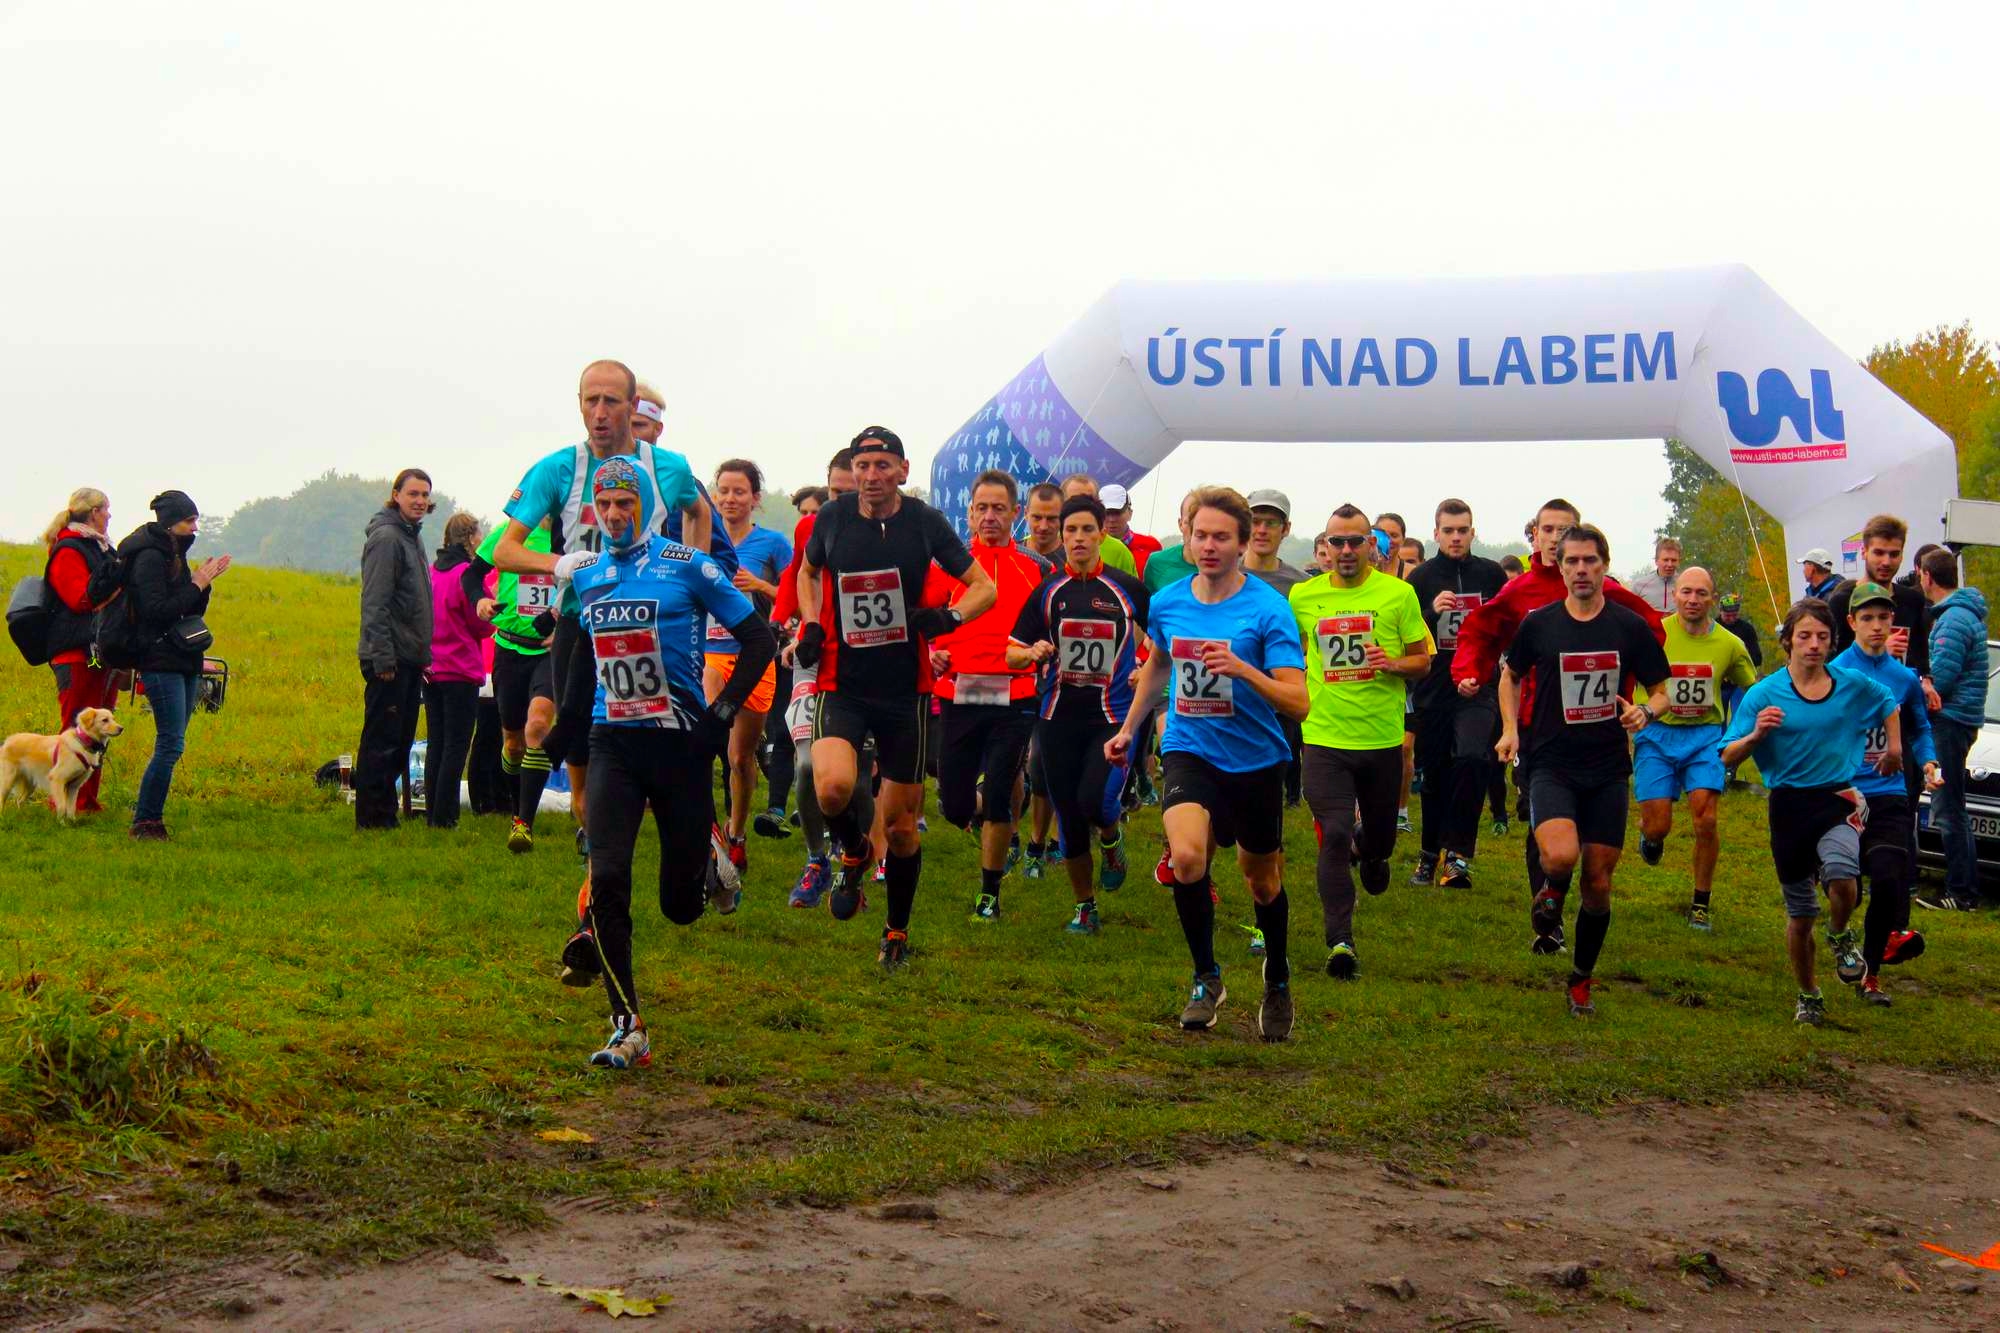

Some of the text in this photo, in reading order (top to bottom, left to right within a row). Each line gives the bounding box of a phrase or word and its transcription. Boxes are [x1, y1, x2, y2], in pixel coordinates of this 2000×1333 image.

[1148, 327, 1678, 387] ÚSTÍ NAD LABEM
[1731, 448, 1846, 462] www.usti-nad-labem.cz
[663, 550, 691, 560] BANK
[529, 586, 549, 606] 31
[853, 593, 894, 629] 53
[594, 606, 650, 624] SAXO
[1448, 612, 1463, 636] 5
[1069, 640, 1105, 672] 20
[1329, 635, 1366, 667] 25
[601, 656, 661, 701] 103
[1182, 661, 1221, 698] 32
[1574, 673, 1610, 706] 74
[1676, 679, 1706, 705] 85
[791, 695, 816, 724] 79
